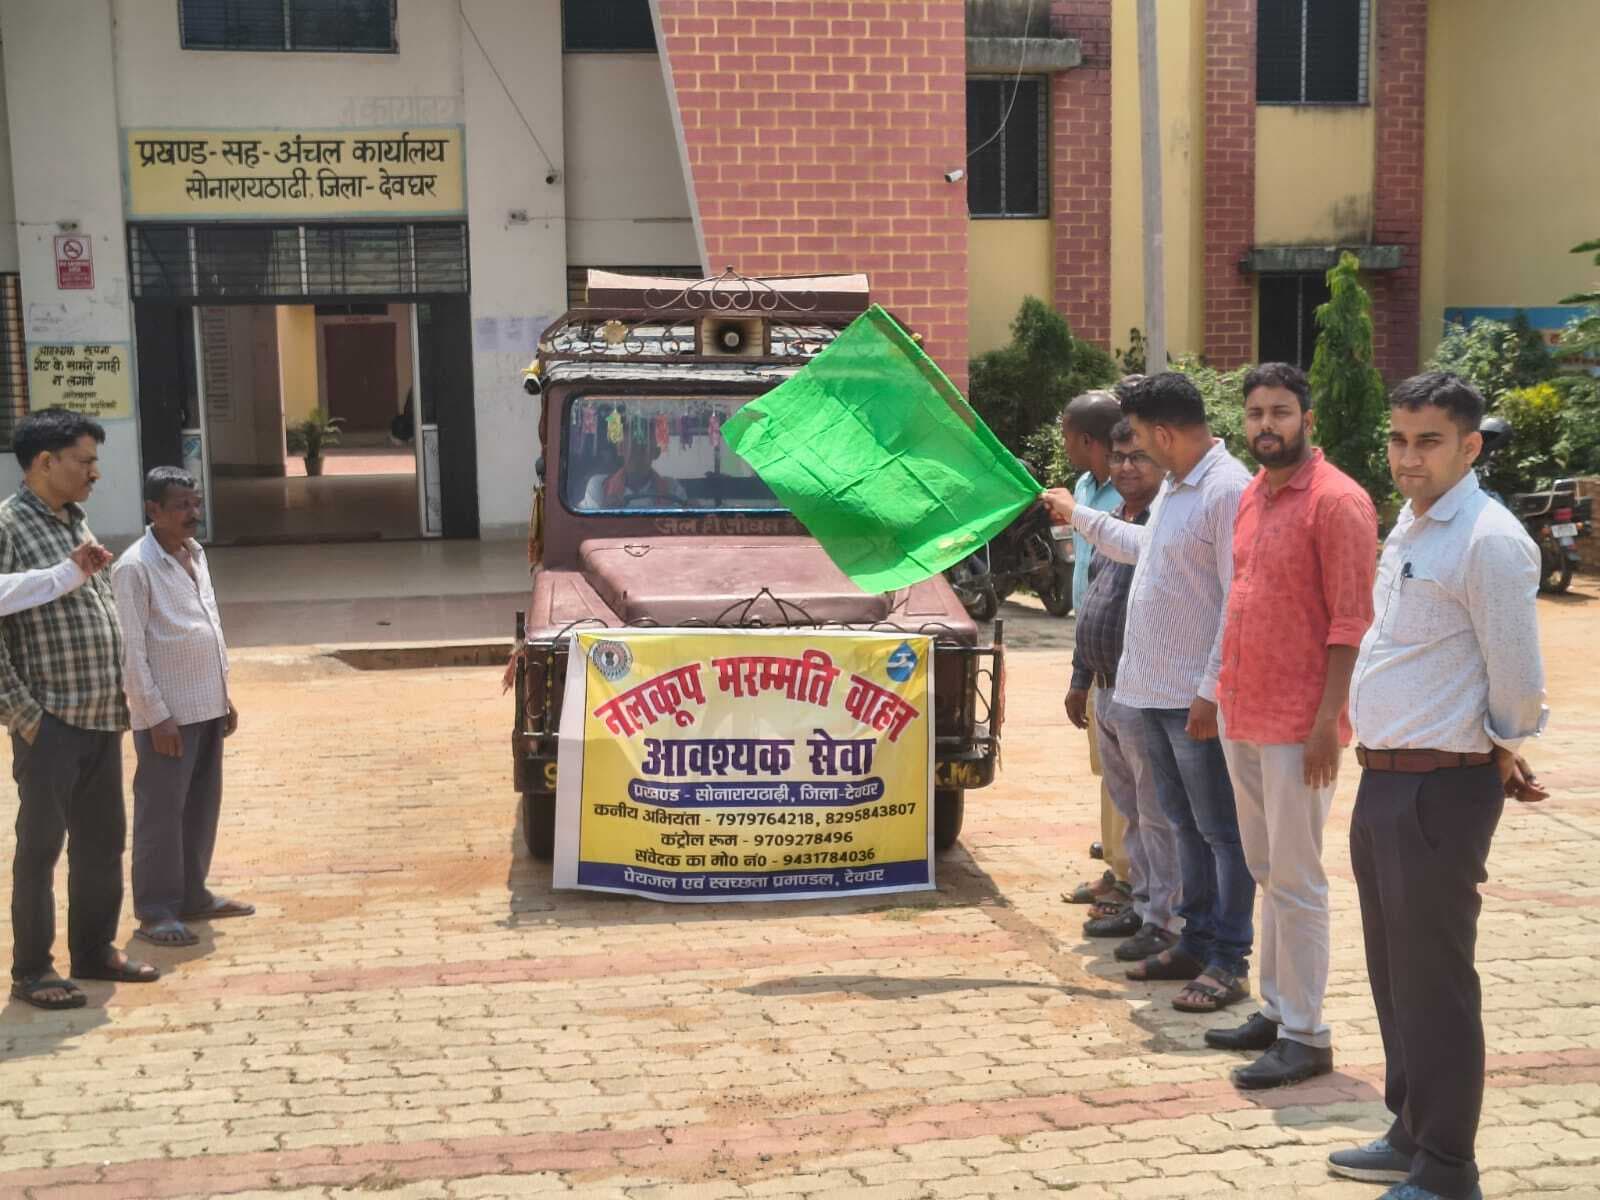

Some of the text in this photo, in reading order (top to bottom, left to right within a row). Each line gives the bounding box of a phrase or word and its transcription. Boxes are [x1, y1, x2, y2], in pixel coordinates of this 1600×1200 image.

[352, 132, 449, 163] कार्यालय
[593, 663, 706, 738] नलकूप
[711, 649, 841, 708] मरम्मति
[845, 674, 920, 743] वाहन
[641, 728, 877, 776] आवश्यक सेवा
[634, 784, 680, 801] प्रखण्ड
[593, 802, 639, 820] कनीय
[642, 808, 701, 826] अभियंता
[825, 802, 916, 825] 8295843807
[660, 830, 704, 849] कंट्रोल
[709, 834, 737, 847] रूम
[754, 831, 854, 847] 9709278496
[635, 847, 682, 867] संवेदक
[685, 854, 706, 867] का
[783, 848, 876, 866] 9431784036
[623, 867, 676, 889] पेयजल
[682, 876, 705, 890] एवं
[709, 877, 768, 889] स्वच्छता
[844, 867, 885, 884] देवघर
